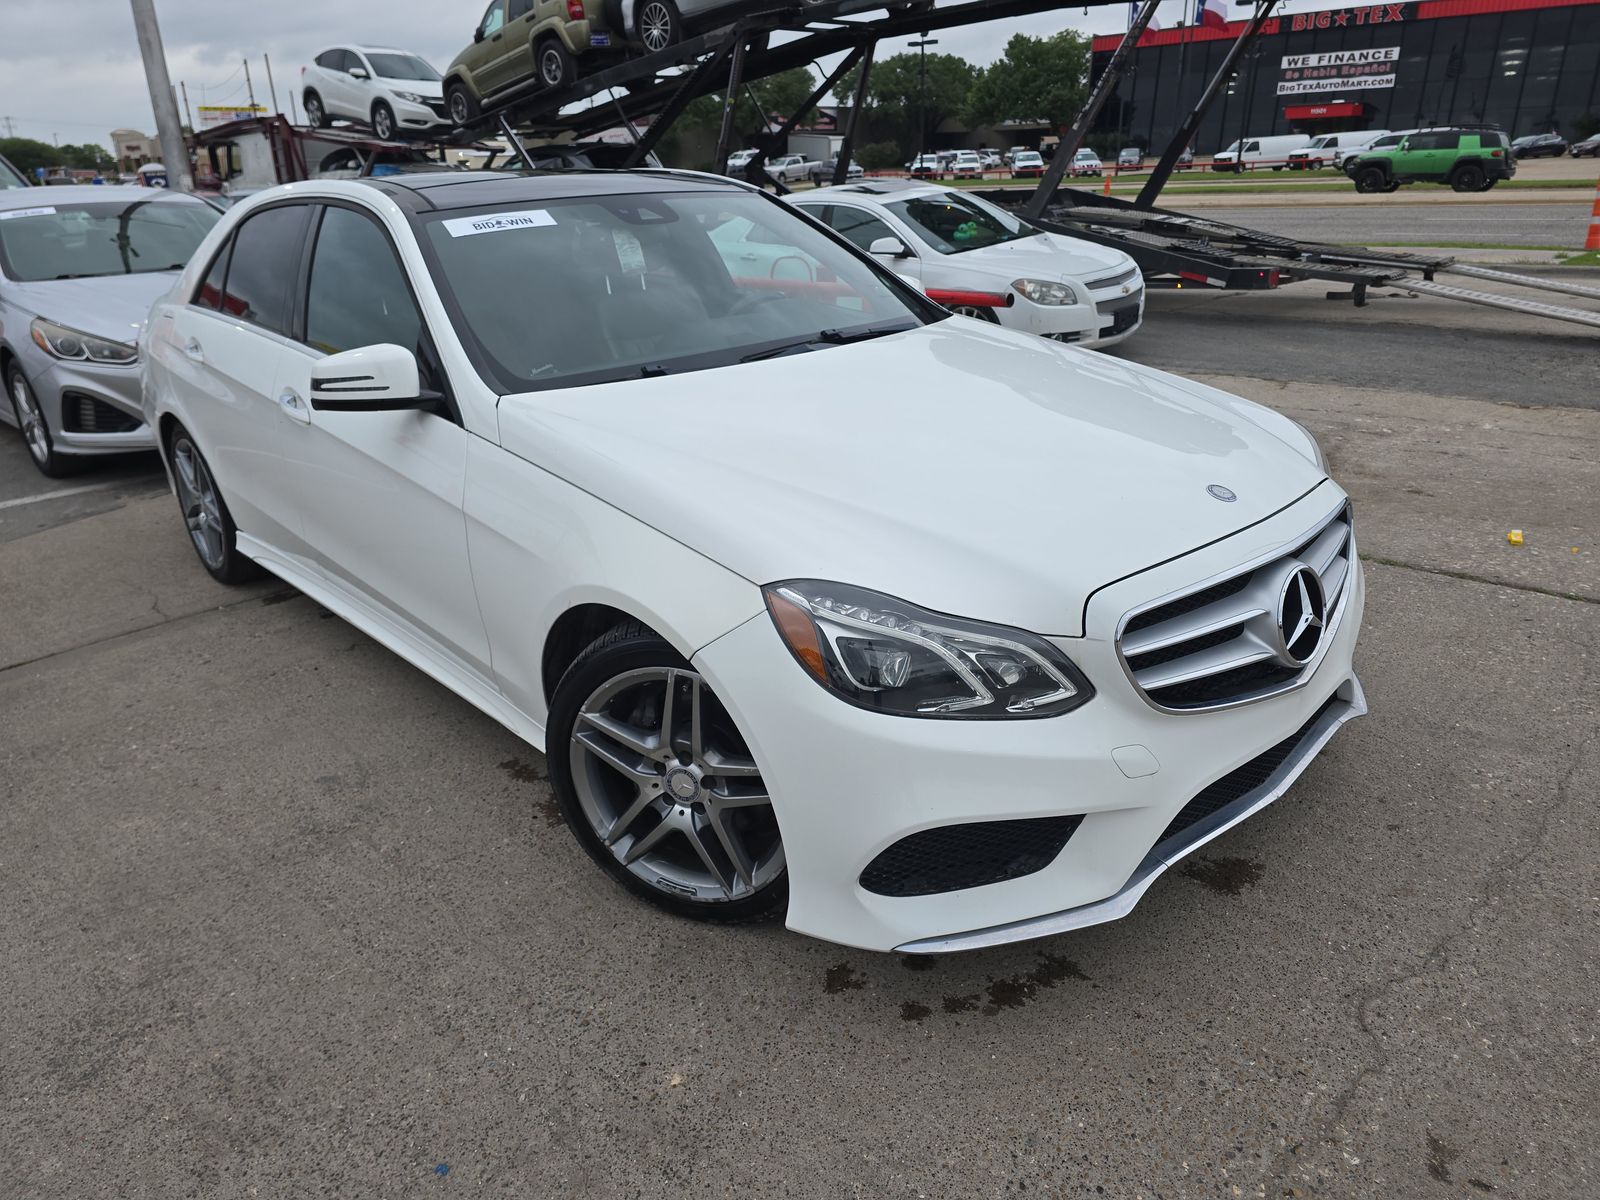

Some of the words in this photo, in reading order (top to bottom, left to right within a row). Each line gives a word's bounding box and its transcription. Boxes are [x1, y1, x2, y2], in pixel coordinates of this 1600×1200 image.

[1291, 11, 1332, 31] BIG
[1353, 3, 1406, 25] TEX
[1287, 56, 1310, 67] WE
[1317, 49, 1394, 65] FINANCE
[1341, 62, 1391, 76] Español
[472, 221, 495, 231] BID
[506, 217, 534, 226] WIN
